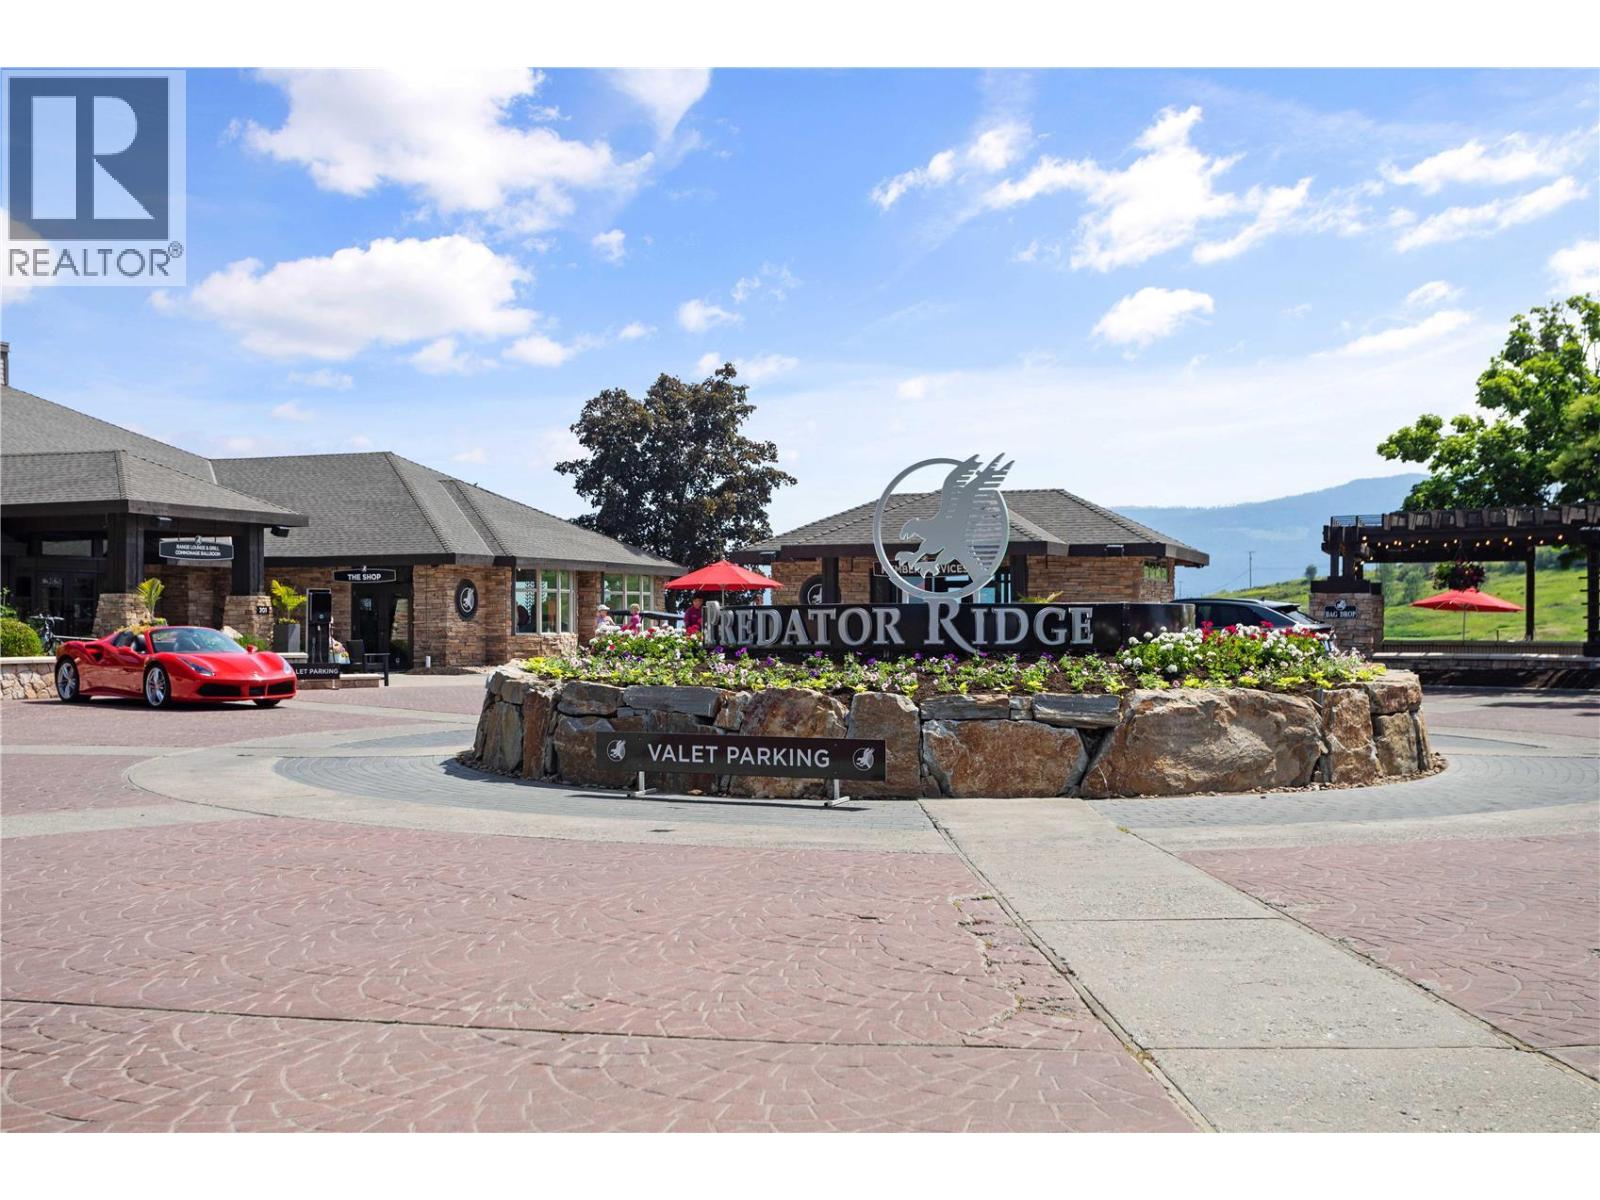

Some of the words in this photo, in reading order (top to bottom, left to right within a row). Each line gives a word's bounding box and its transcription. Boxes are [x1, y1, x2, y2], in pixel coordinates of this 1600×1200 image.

[347, 573, 361, 581] THE
[362, 573, 382, 581] SHOP
[704, 600, 905, 648] PREDATOR
[923, 598, 1094, 656] RIDGE
[647, 743, 719, 764] VALET
[726, 748, 830, 768] PARKING
